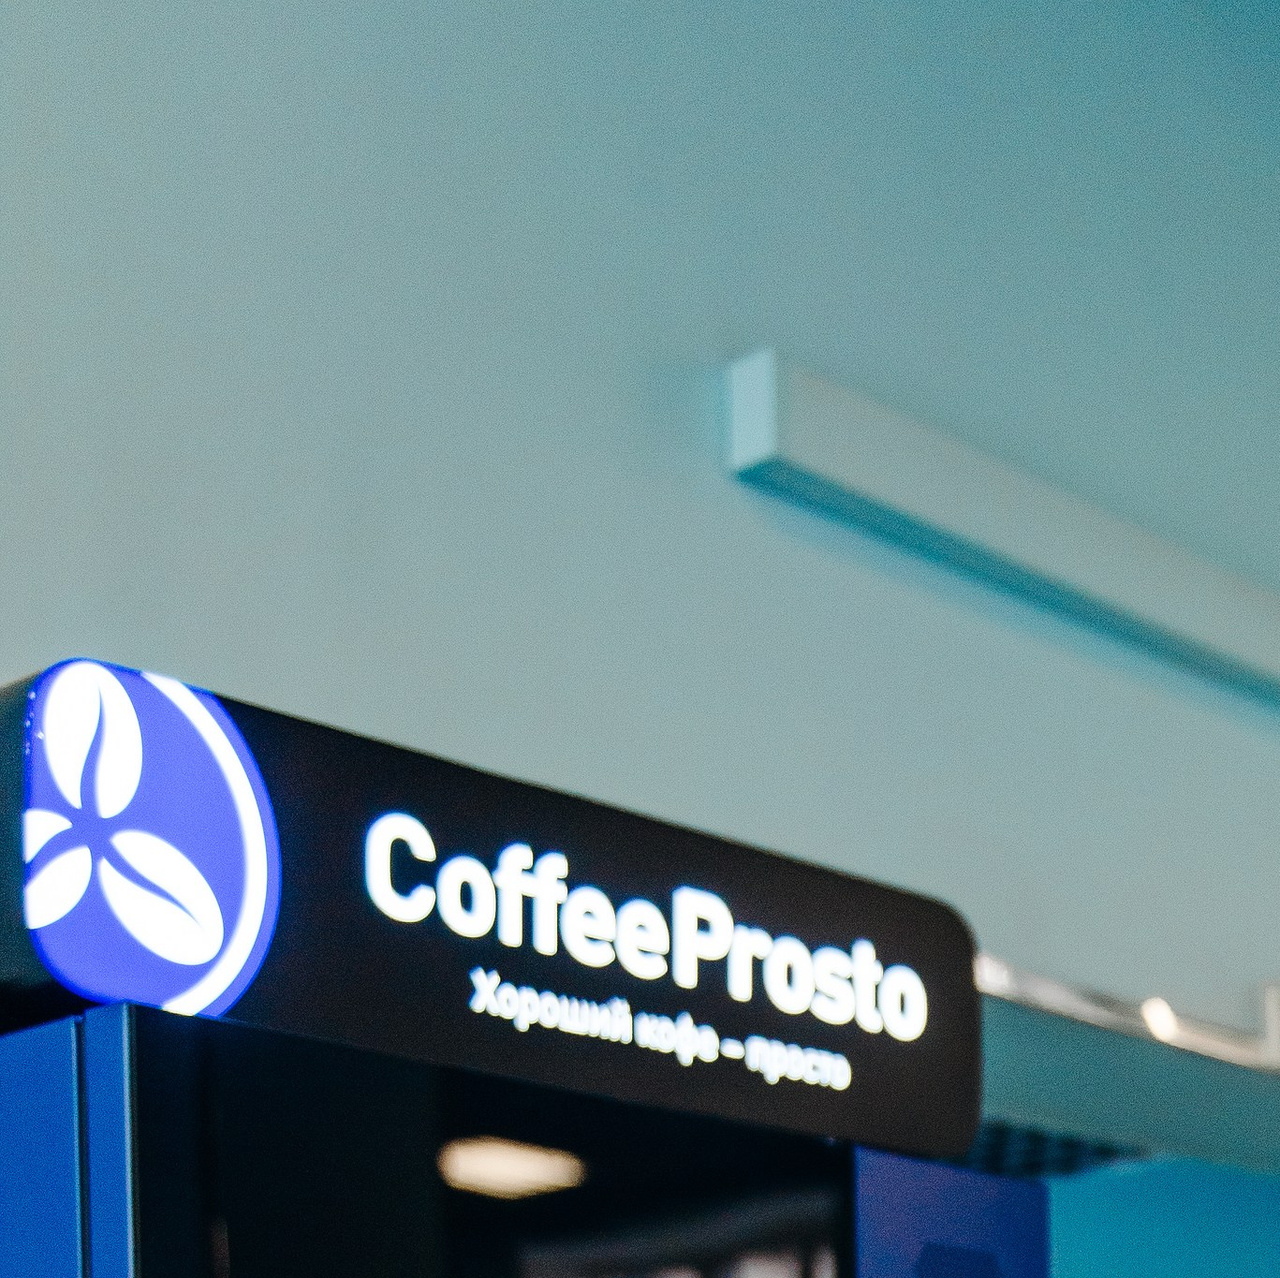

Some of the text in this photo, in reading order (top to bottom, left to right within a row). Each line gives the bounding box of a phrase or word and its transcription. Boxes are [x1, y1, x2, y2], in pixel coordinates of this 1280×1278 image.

[364, 811, 928, 1042] CoffeeProsto
[468, 966, 632, 1044] Хороший
[633, 1011, 719, 1066] кофе
[745, 1034, 852, 1091] просто
